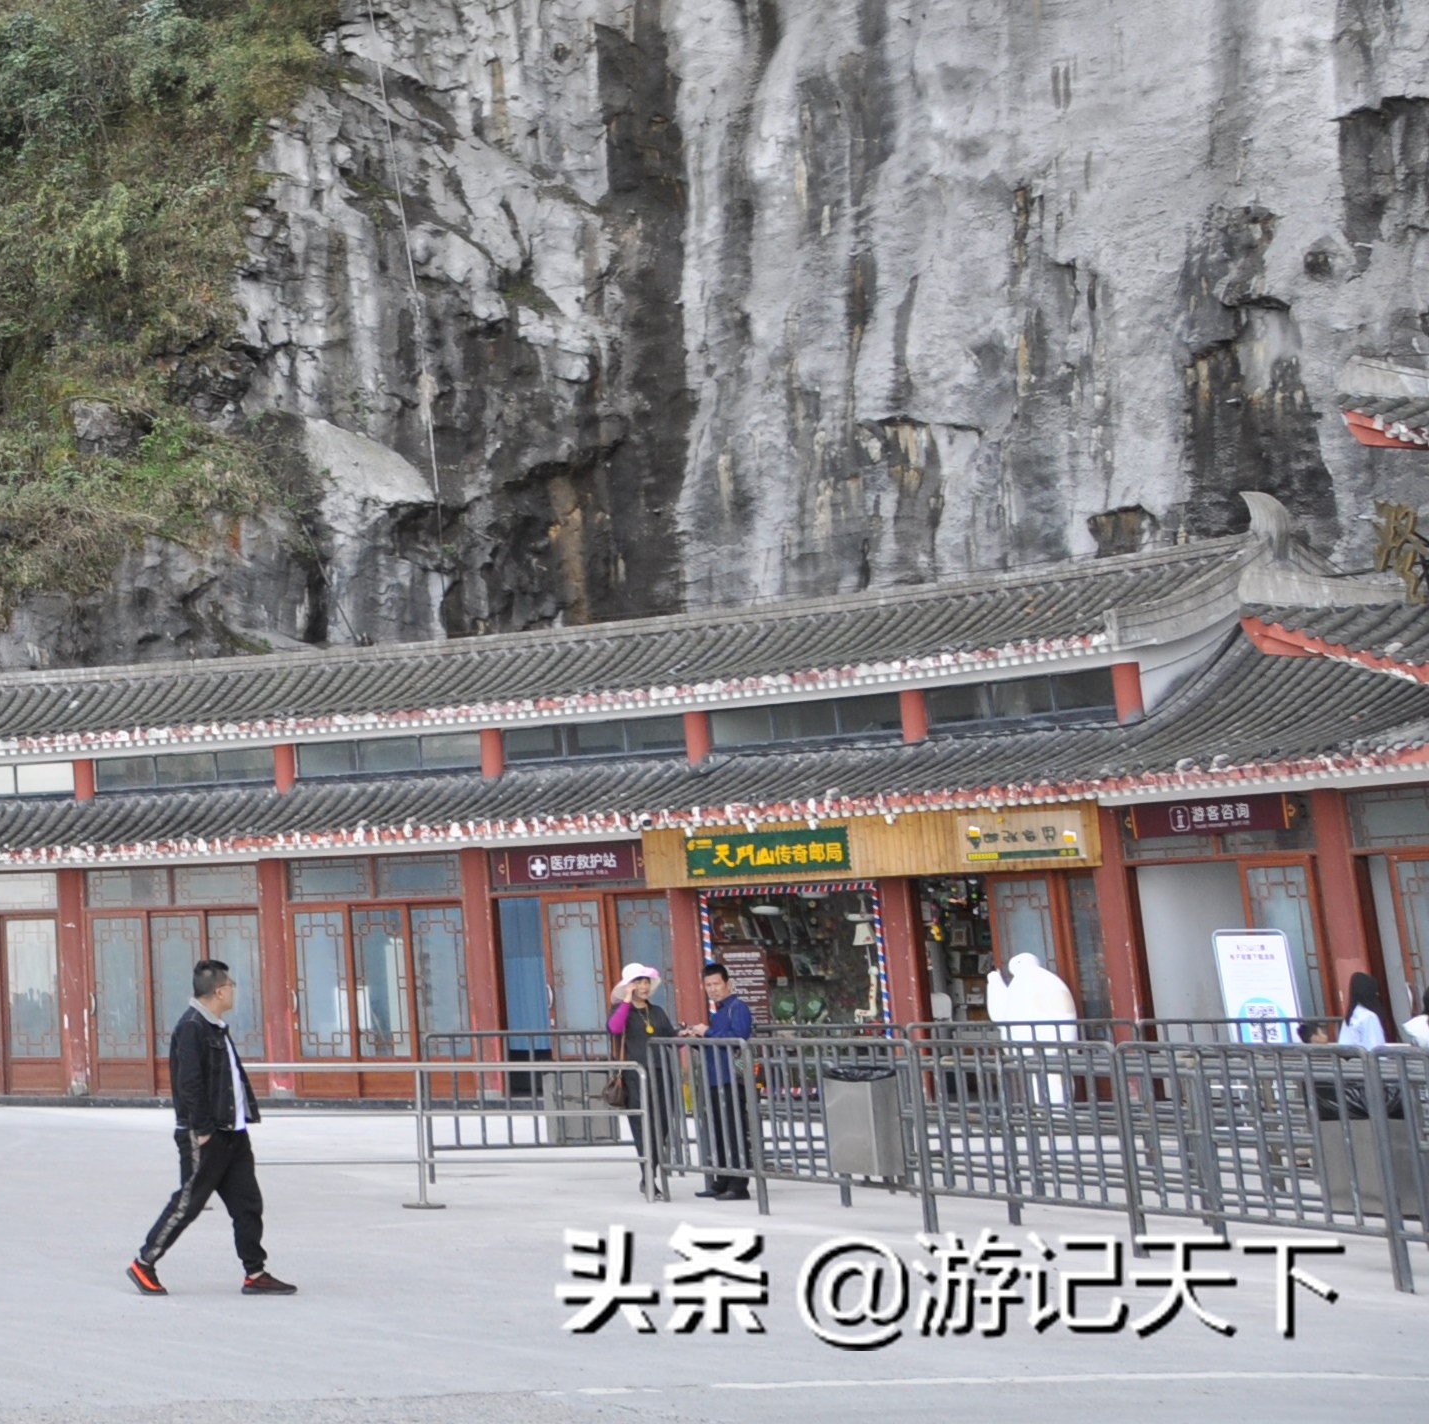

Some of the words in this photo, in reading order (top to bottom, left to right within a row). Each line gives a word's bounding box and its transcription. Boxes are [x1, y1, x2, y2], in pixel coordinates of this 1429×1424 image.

[1191, 802, 1251, 823] 游客咨询
[550, 851, 618, 871] 医疗救护站
